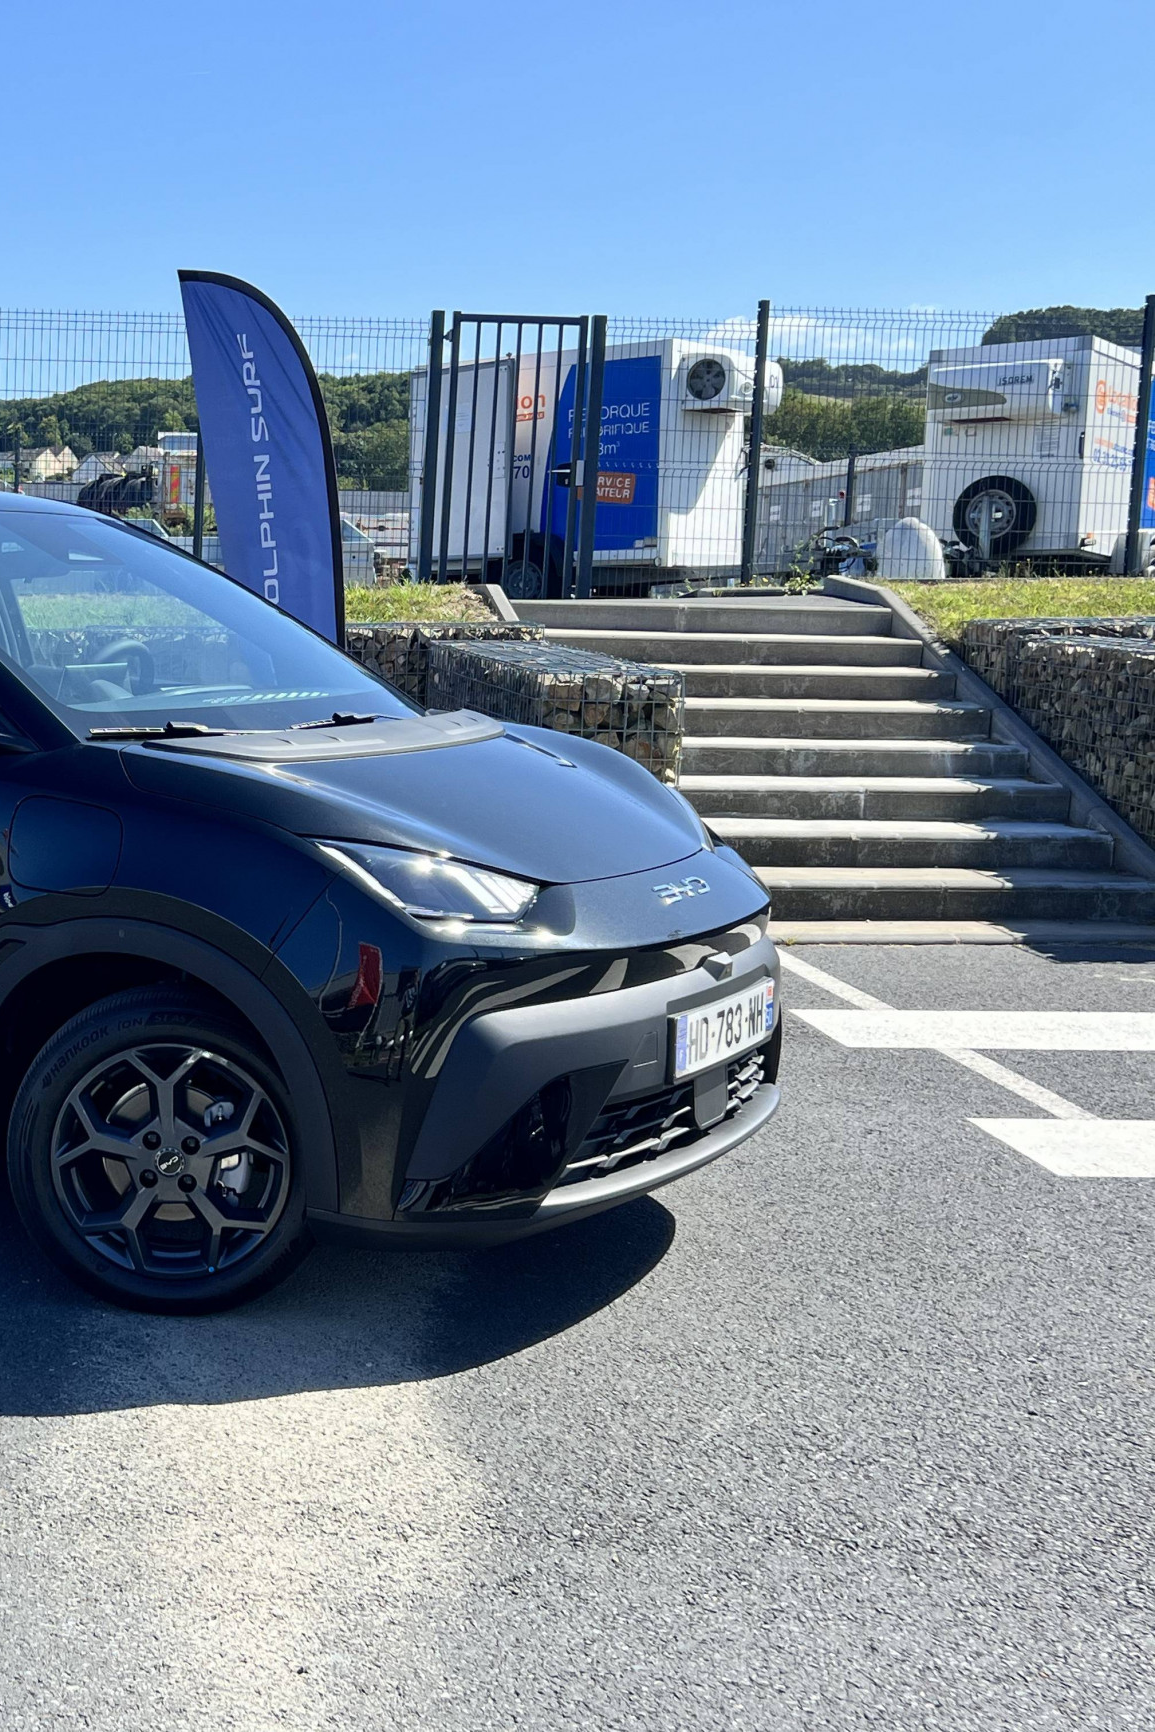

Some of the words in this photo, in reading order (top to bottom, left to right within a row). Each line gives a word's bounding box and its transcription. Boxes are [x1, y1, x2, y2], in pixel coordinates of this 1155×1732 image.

[237, 333, 270, 442] SURF
[568, 403, 650, 422] REORQUE
[568, 422, 650, 439] FIORIFIQUE
[598, 476, 631, 488] RVICE
[596, 488, 631, 498] AITEUR
[252, 455, 280, 604] OLPHIN
[687, 991, 765, 1065] HD-783-NH
